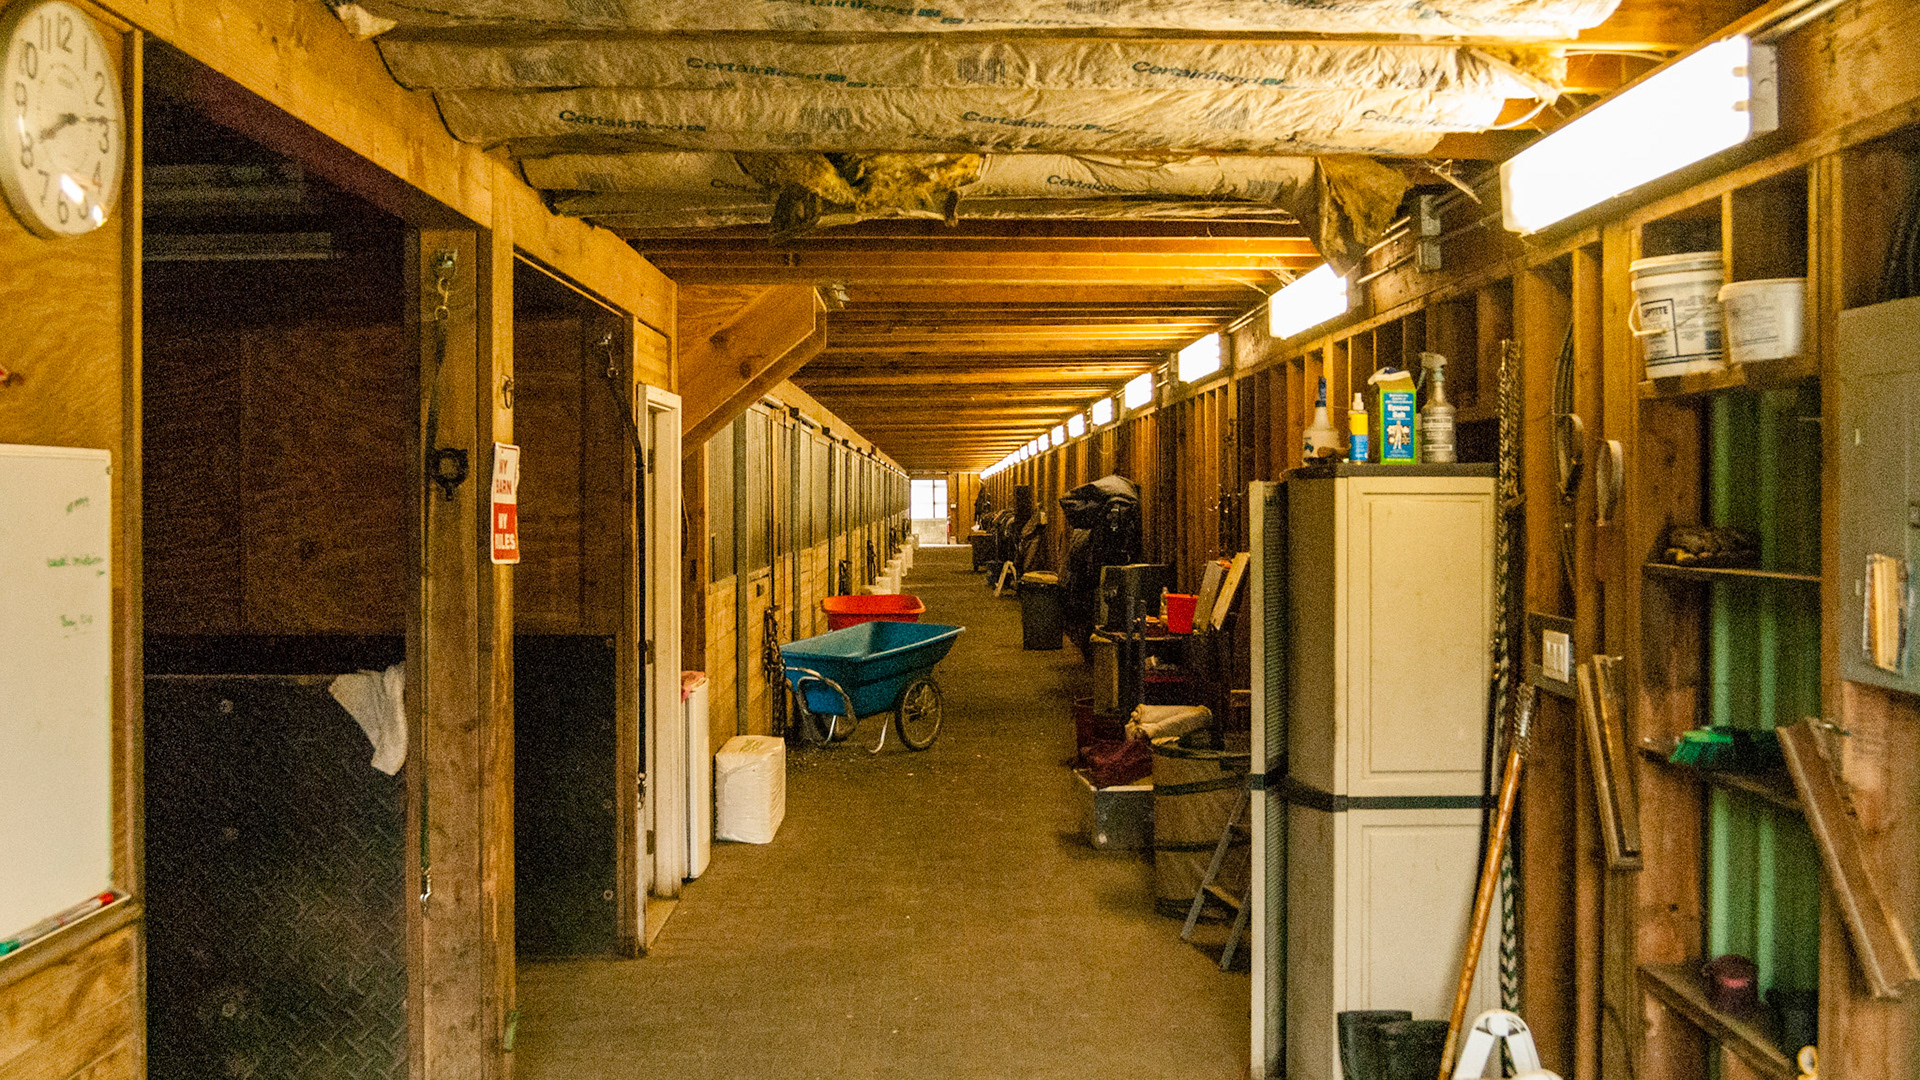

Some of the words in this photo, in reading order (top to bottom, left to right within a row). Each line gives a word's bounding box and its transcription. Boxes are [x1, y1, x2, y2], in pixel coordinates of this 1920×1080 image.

[38, 13, 51, 54] 11
[56, 11, 73, 53] 12
[18, 38, 38, 80] 10
[82, 35, 88, 71] 1
[15, 80, 27, 118] 9
[94, 70, 106, 108] 2
[20, 132, 34, 169] 8
[98, 117, 110, 154] 3
[37, 168, 49, 207] 7
[57, 190, 69, 225] 6
